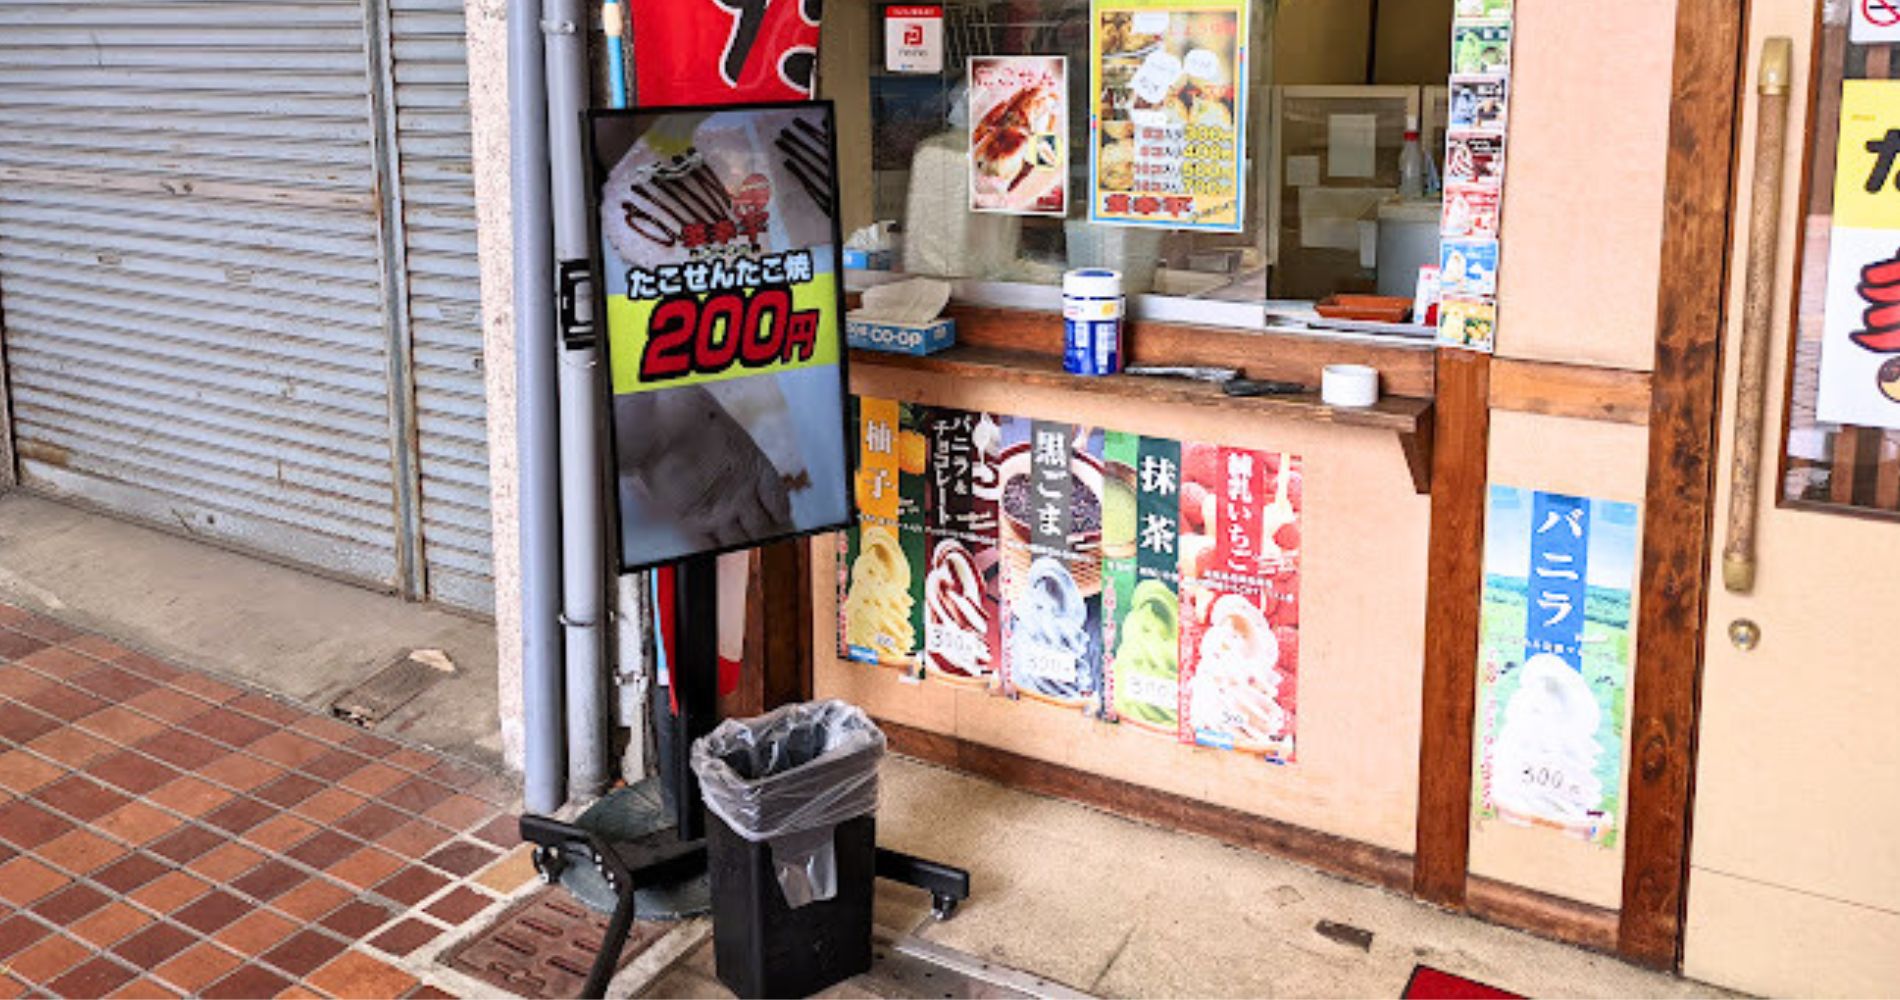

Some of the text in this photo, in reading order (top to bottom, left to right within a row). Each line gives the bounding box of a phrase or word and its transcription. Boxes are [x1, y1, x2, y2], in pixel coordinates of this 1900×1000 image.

[628, 252, 813, 299] たこせんたこ焼
[641, 288, 819, 379] 200円
[865, 419, 893, 499] 柚子
[933, 419, 951, 525] チョコレート
[1035, 430, 1068, 537] 黒ごま
[1139, 455, 1177, 554] 抹茶
[1535, 507, 1585, 628] バニラ
